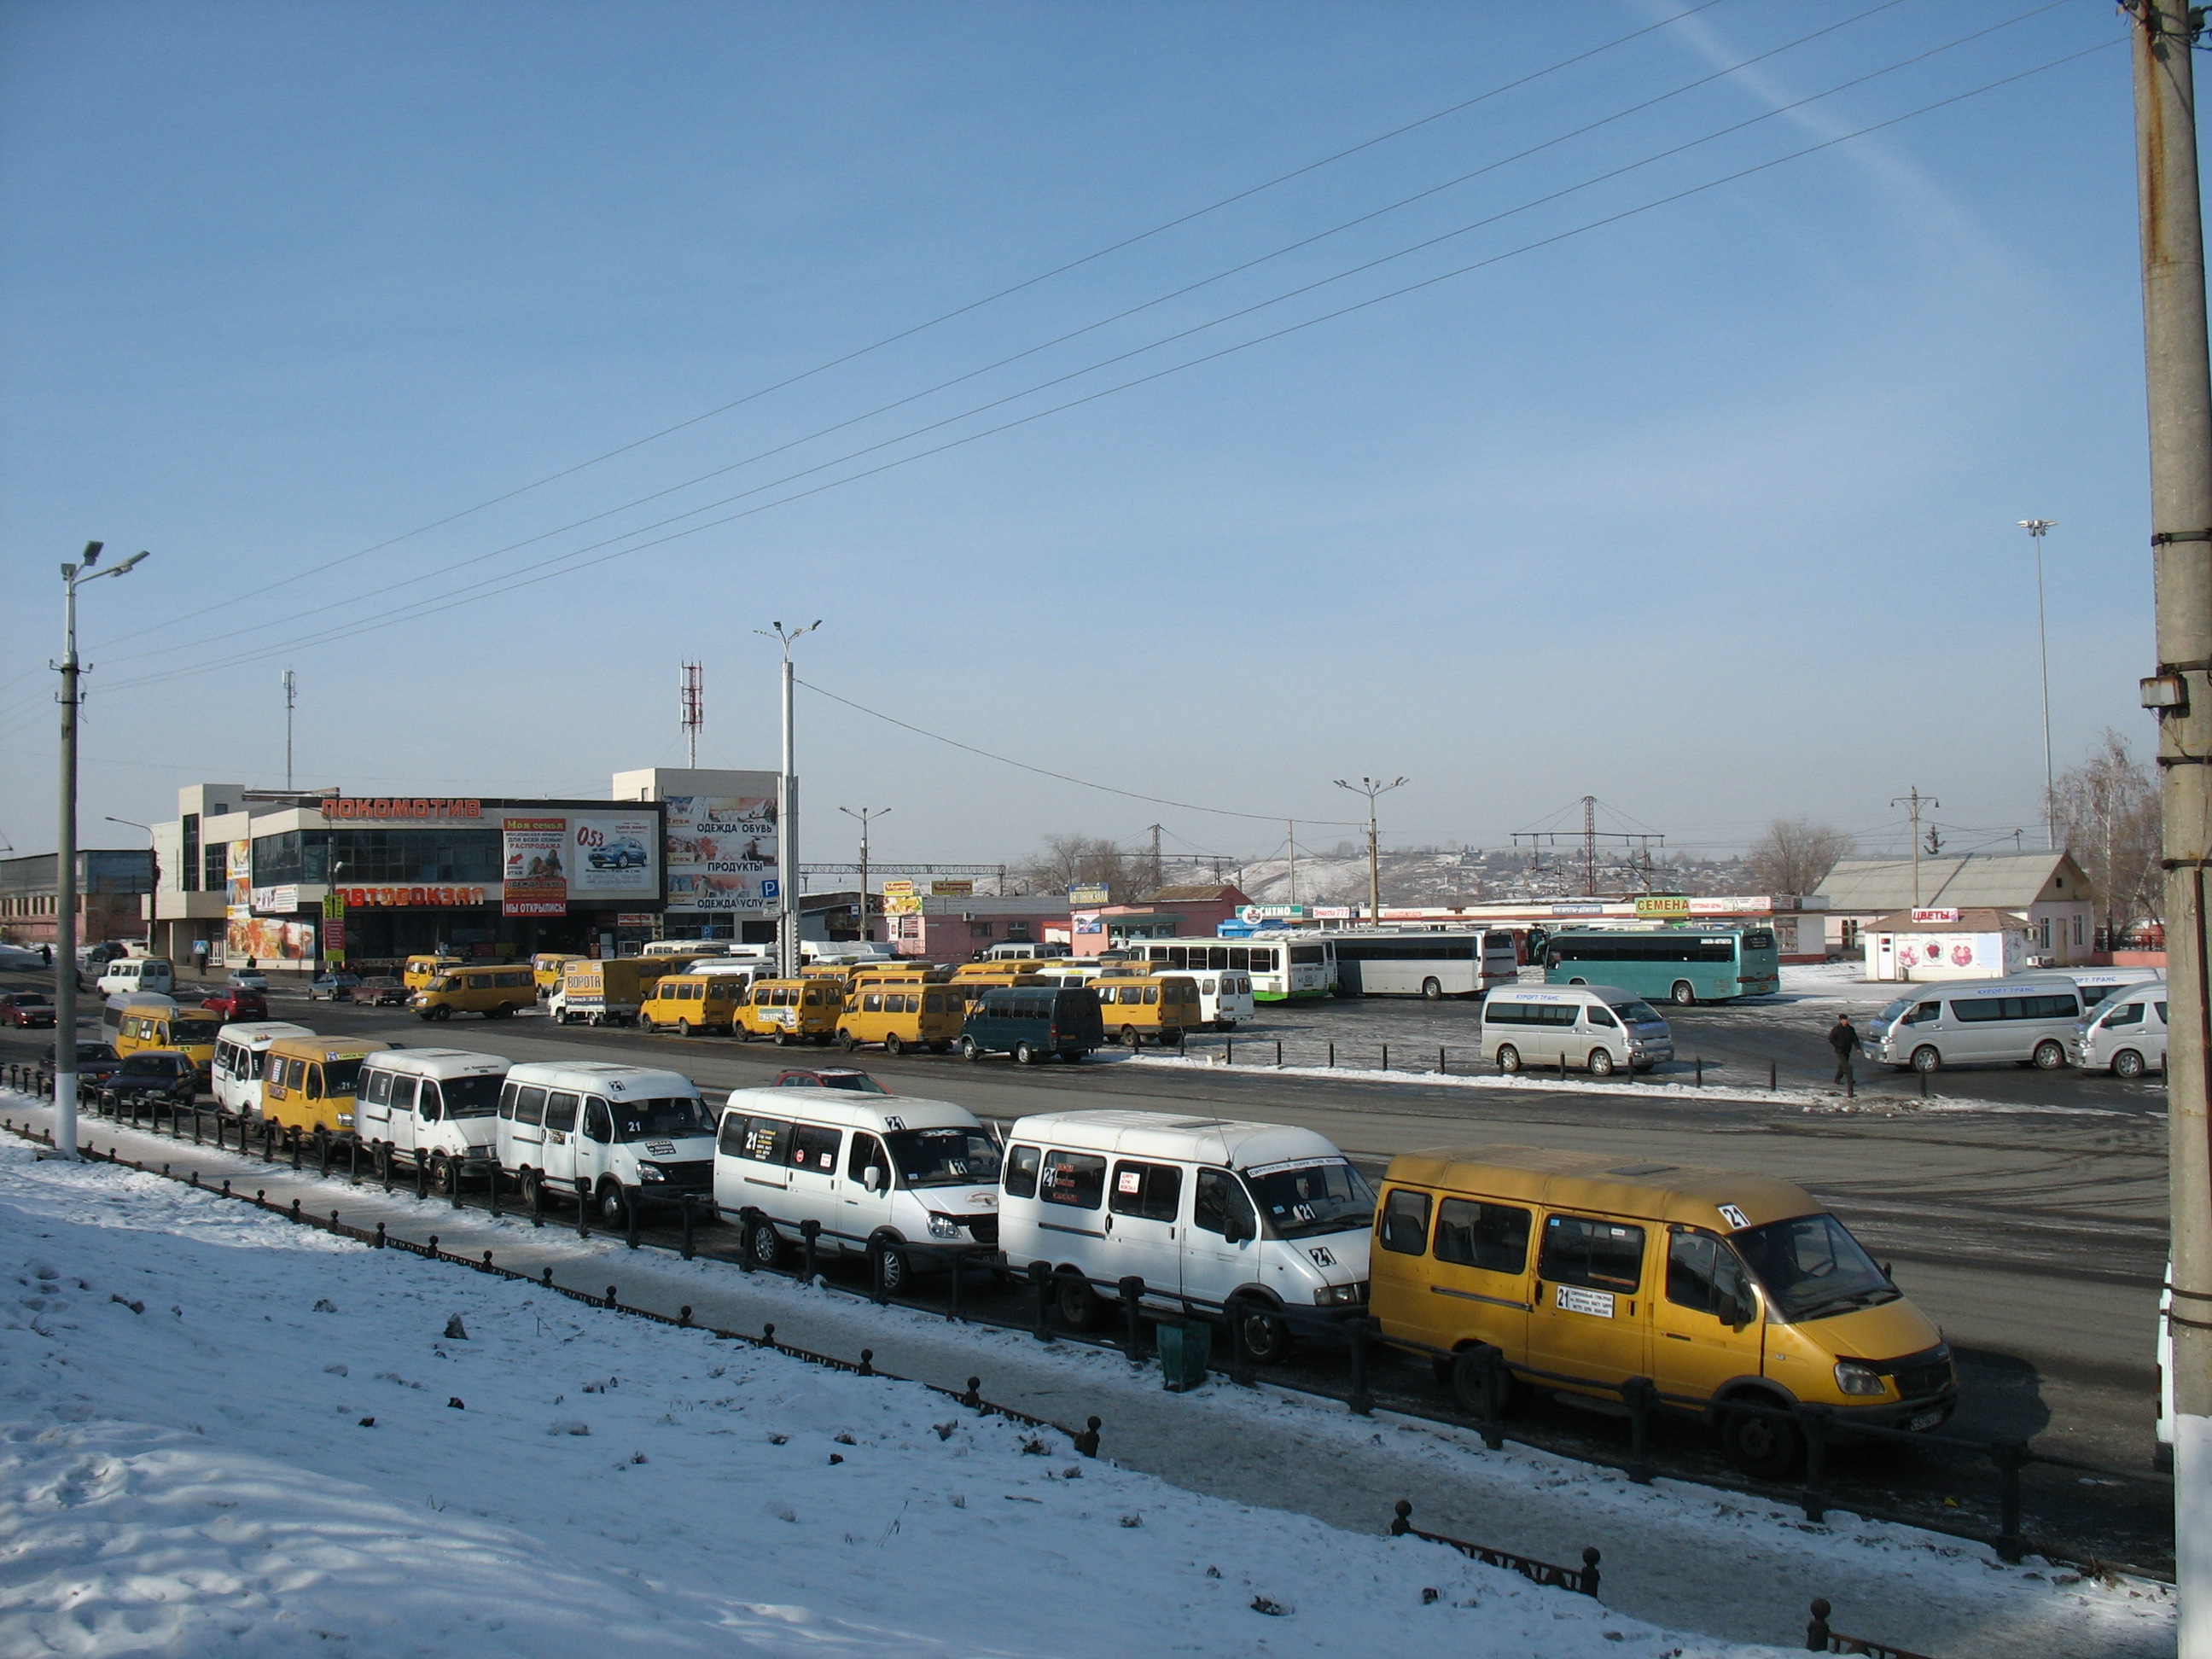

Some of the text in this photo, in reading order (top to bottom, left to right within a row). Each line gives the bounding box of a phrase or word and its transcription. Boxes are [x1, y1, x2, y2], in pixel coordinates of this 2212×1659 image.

[321, 799, 480, 818] ЛОКОМОТИВ
[696, 824, 772, 833] ОДЕЖДА ОБУВЬ
[577, 826, 604, 848] 053
[707, 862, 763, 872] ПРОДУКТЫ
[506, 904, 518, 912] МЫ
[697, 899, 737, 908] ОДЕЖДА
[1638, 899, 1689, 911] СЕМЕНА
[1912, 911, 1950, 922] ЦВЕТЫ
[568, 975, 601, 988] ВОРОТА
[341, 1081, 350, 1090] 21
[612, 1081, 624, 1091] 21
[627, 1121, 641, 1132] 21
[888, 1117, 905, 1130] 21
[745, 1132, 758, 1150] 21
[955, 1161, 968, 1174] 21
[1044, 1168, 1057, 1186] 21
[1299, 1204, 1315, 1220] 21
[1722, 1207, 1749, 1227] 21
[1313, 1248, 1336, 1266] 21
[1558, 1288, 1569, 1308] 21
